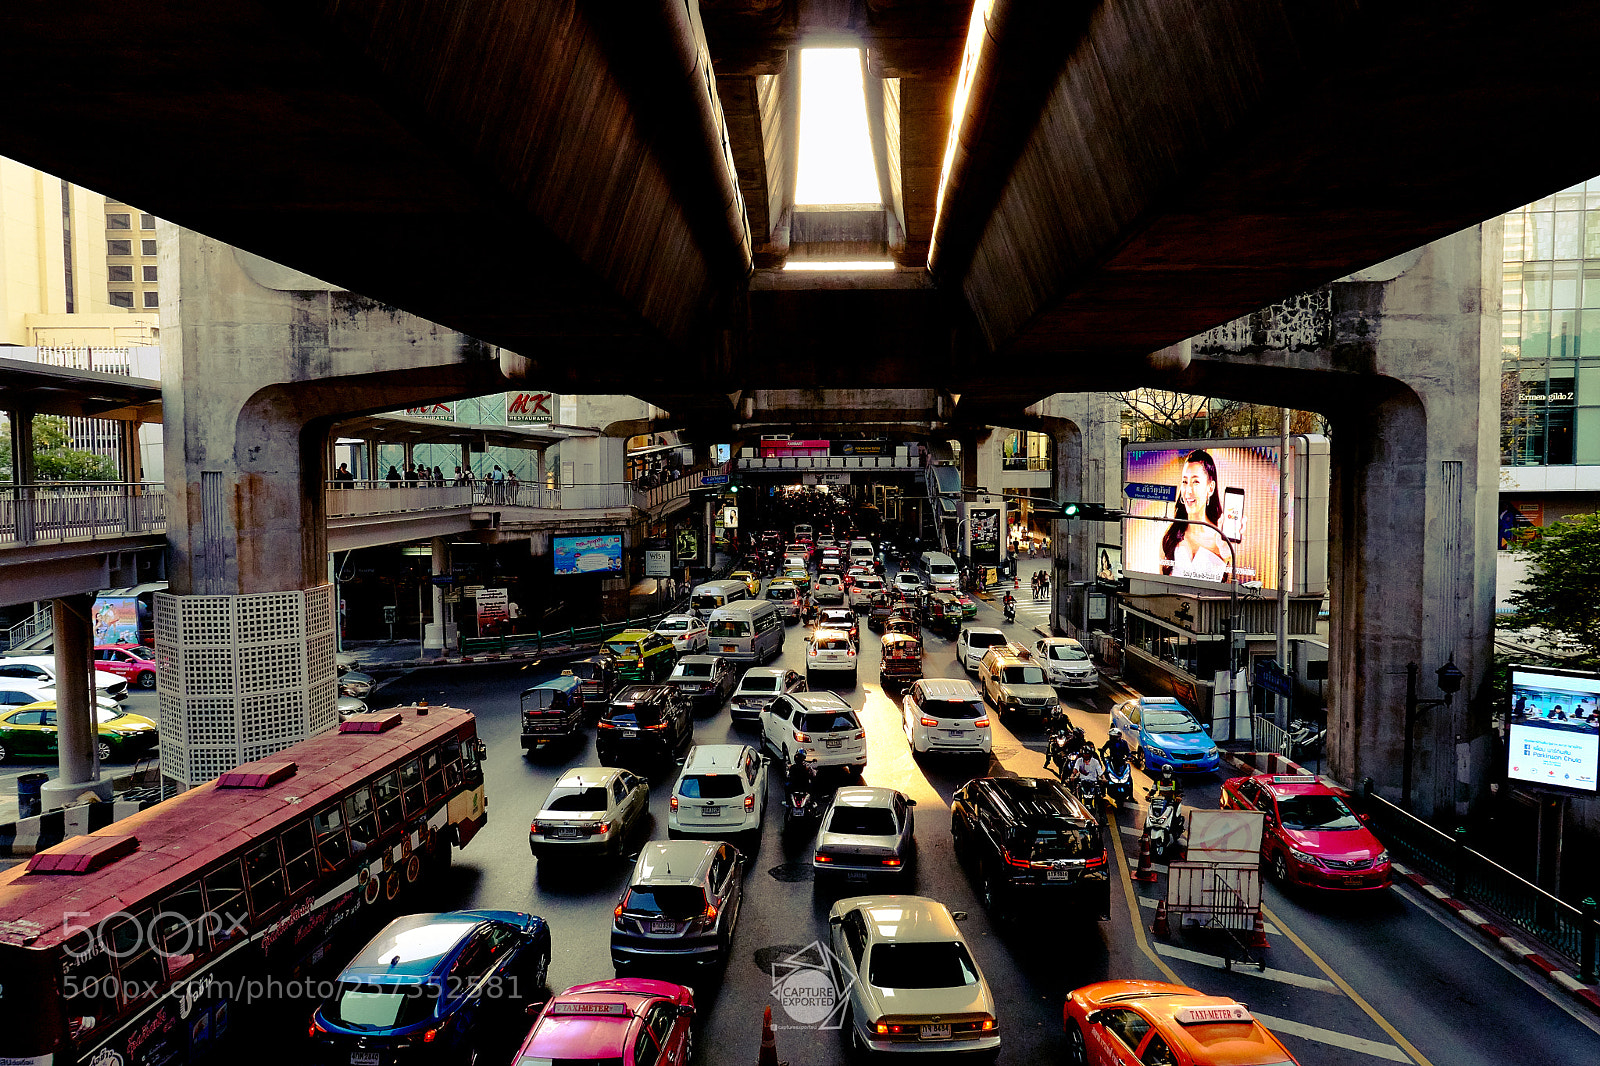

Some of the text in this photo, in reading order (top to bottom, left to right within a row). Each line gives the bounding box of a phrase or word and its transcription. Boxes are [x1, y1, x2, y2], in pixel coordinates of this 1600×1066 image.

[1519, 393, 1567, 402] Ermengildo
[509, 393, 552, 414] MK
[1533, 751, 1562, 760] Parkinson
[1563, 755, 1582, 764] Chula
[562, 1004, 610, 1013] TAXI-METER
[1189, 1009, 1232, 1020] TAXI-METER
